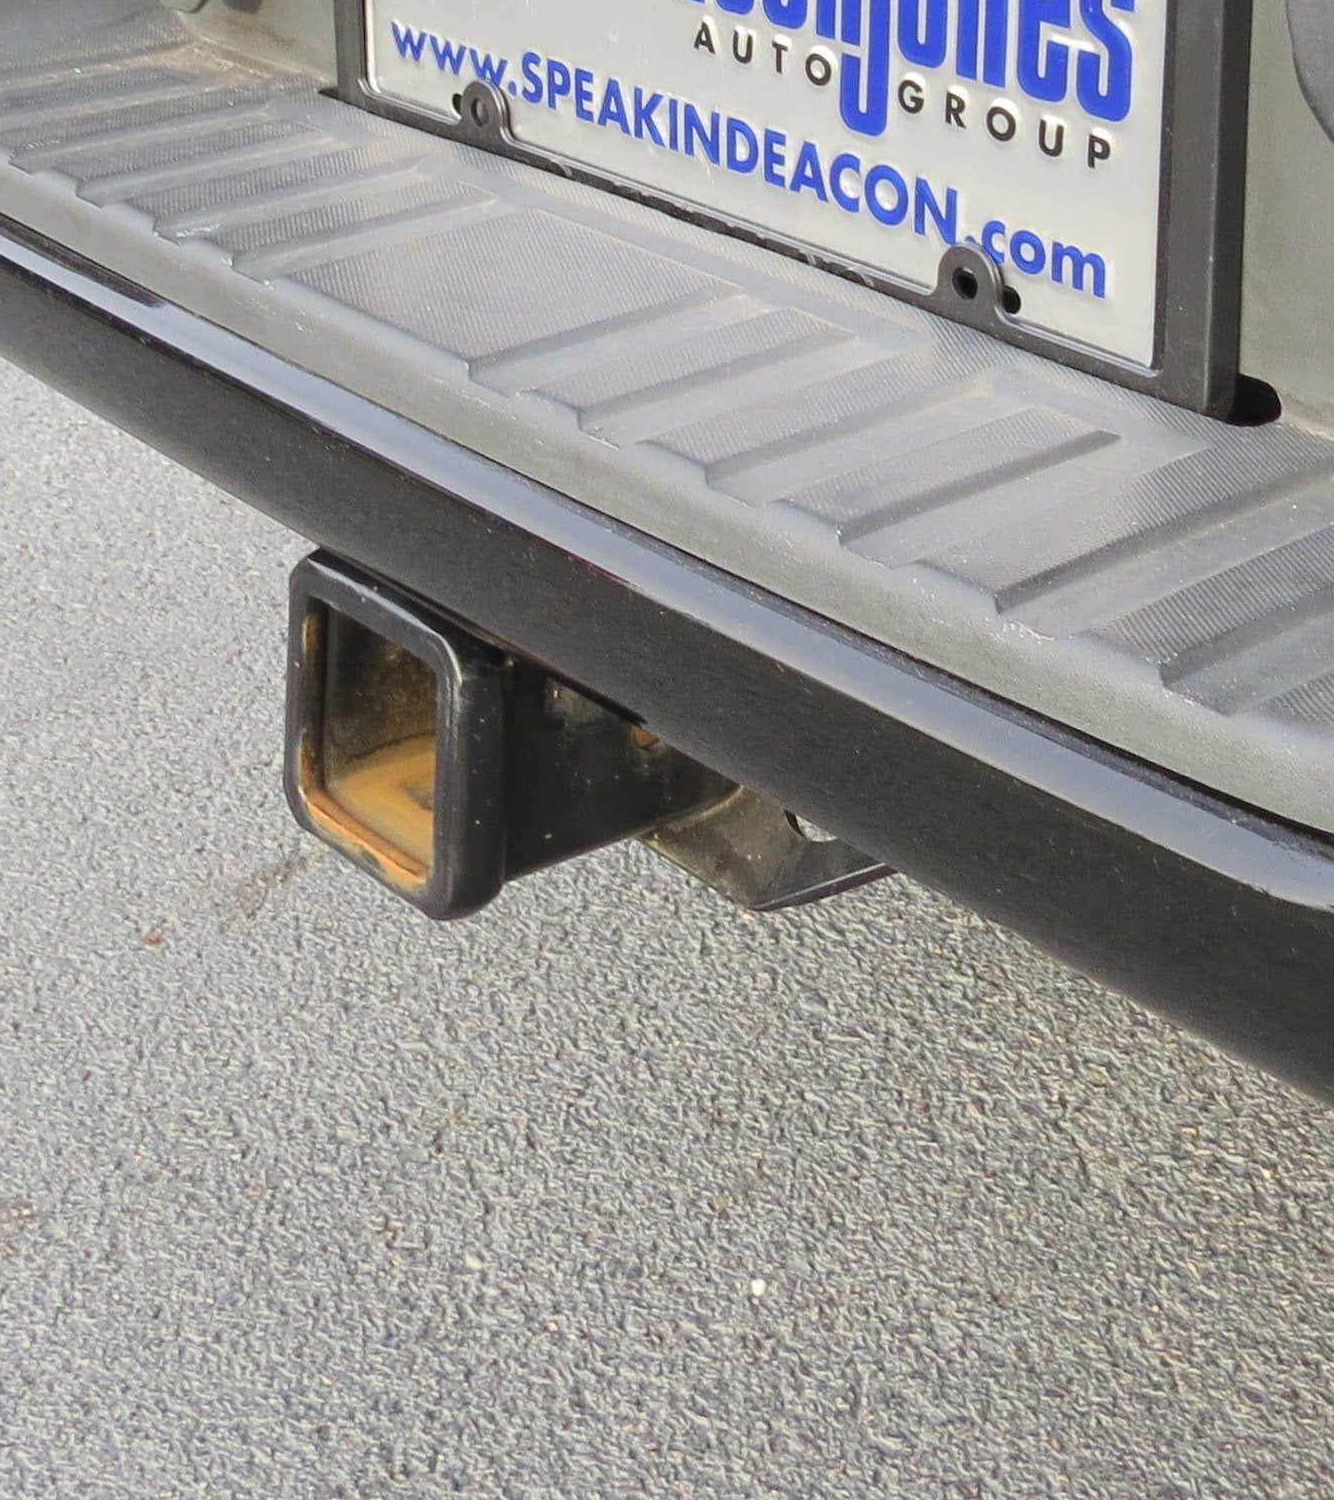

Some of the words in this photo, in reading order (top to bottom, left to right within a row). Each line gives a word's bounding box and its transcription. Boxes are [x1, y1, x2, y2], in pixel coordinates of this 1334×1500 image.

[389, 19, 1108, 299] www.SPEAKINDEACON.com
[693, 22, 833, 88] AUTO
[897, 77, 1112, 170] GROUP
